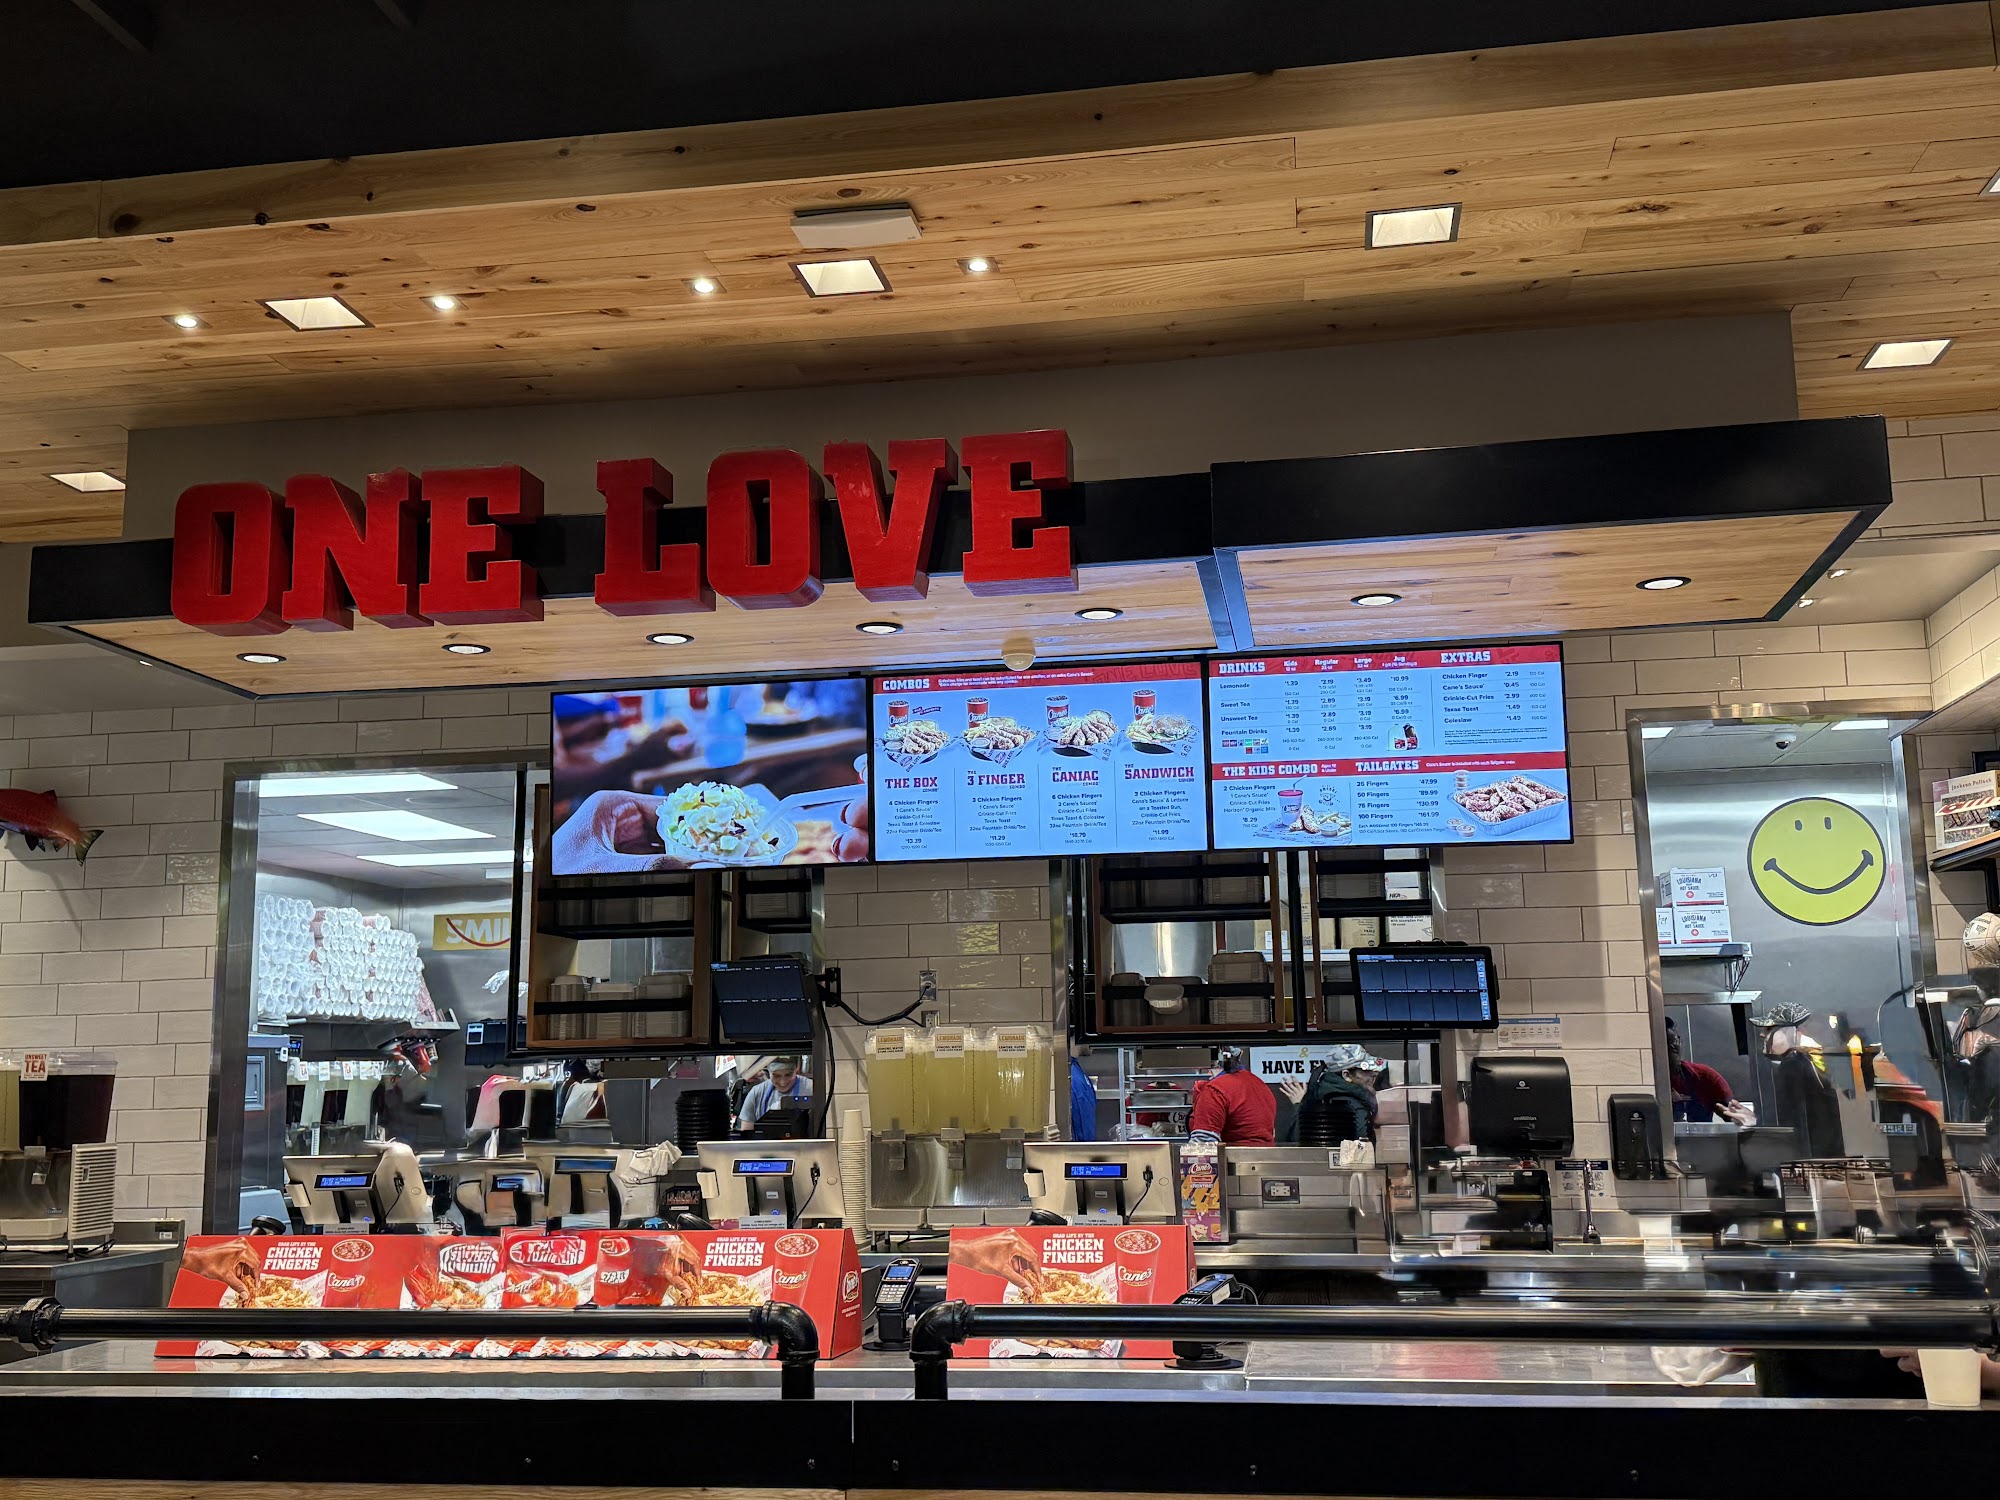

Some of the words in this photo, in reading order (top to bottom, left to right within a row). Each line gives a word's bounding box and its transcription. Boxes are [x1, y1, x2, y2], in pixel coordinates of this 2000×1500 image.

[170, 462, 544, 636] ONE
[594, 429, 1079, 617] LOVE
[1354, 657, 1372, 665] Large
[1440, 651, 1491, 664] EXTRAS
[1219, 662, 1266, 674] DRINKS
[882, 678, 930, 691] COMBOS
[1222, 766, 1246, 777] THE
[1248, 765, 1276, 776] KIDS
[1278, 763, 1318, 775] COMBO
[1355, 760, 1419, 772] TAILGATES
[1052, 770, 1099, 783] CANIAC
[1124, 766, 1195, 780] SANDWICH
[885, 778, 910, 789] THE
[913, 776, 938, 788] BOX
[967, 775, 975, 786] 3
[978, 774, 1026, 786] FINGER
[1951, 782, 1972, 791] Jackson
[1972, 777, 1992, 786] Pollock
[1366, 791, 1390, 799] Fingers
[1676, 877, 1702, 885] LOUISIANA
[1681, 914, 1707, 923] LOUISIANA
[24, 1060, 46, 1073] TEA
[1261, 1060, 1305, 1074] HAVE
[706, 1242, 766, 1254] CHICKEN
[1043, 1238, 1104, 1251] CHICKEN
[266, 1246, 324, 1259] CHICKEN
[1042, 1251, 1104, 1264] FINGERS
[263, 1259, 319, 1270] FINGERS
[703, 1254, 763, 1267] FINGERS
[774, 1268, 808, 1284] Cane's
[1118, 1265, 1153, 1281] Cane's
